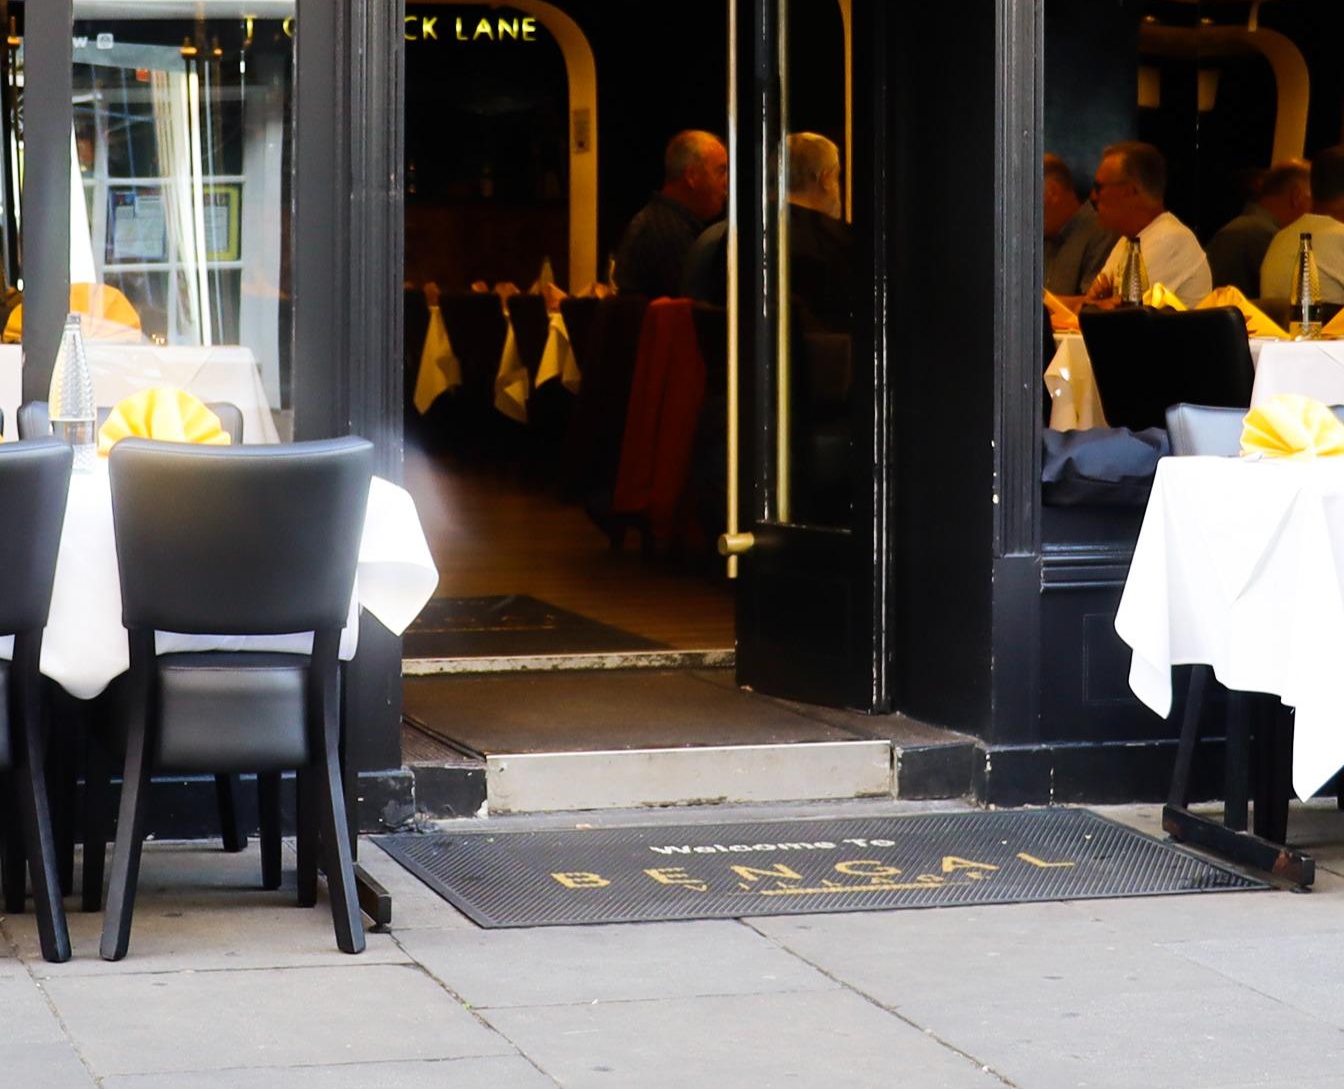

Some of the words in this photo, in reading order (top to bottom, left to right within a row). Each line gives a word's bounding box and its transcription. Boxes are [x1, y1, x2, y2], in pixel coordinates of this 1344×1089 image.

[456, 17, 536, 42] LANE
[649, 841, 837, 855] Welcome
[842, 838, 897, 848] To
[550, 852, 1076, 890] BENGAL
